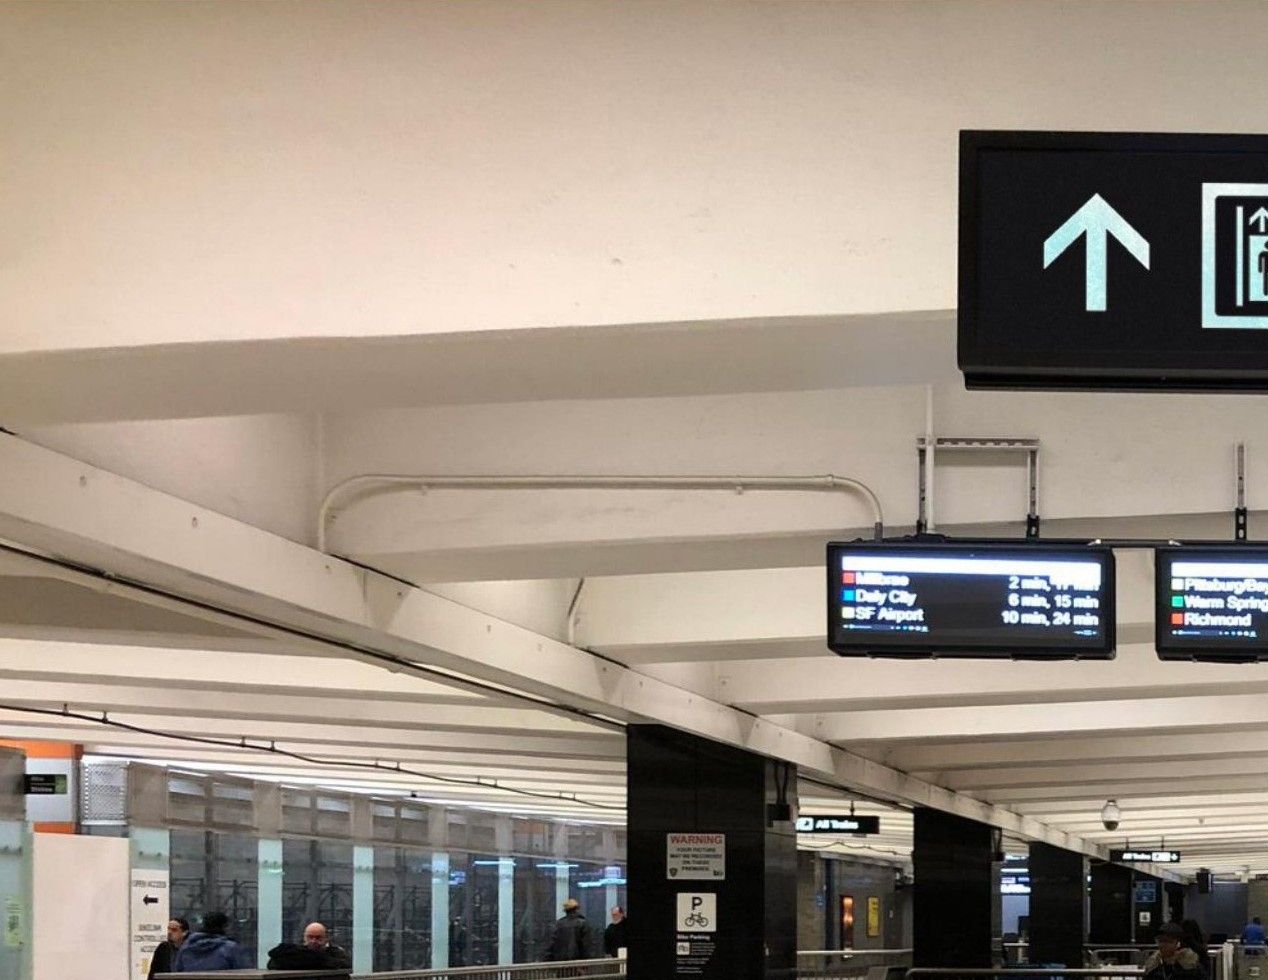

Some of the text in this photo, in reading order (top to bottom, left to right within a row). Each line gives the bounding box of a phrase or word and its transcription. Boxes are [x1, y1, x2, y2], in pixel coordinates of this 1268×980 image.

[1008, 576, 1020, 590] 2
[856, 589, 917, 607] Daly City
[1008, 593, 1099, 610] 6 min, 15 min
[1184, 595, 1225, 608] Warm
[856, 606, 924, 624] SF Airport
[1001, 610, 1099, 627] 10 min, 24 min
[1184, 613, 1252, 626] Richmond
[815, 819, 859, 830] All Trains
[670, 835, 723, 845] WARNING
[691, 896, 703, 911] P
